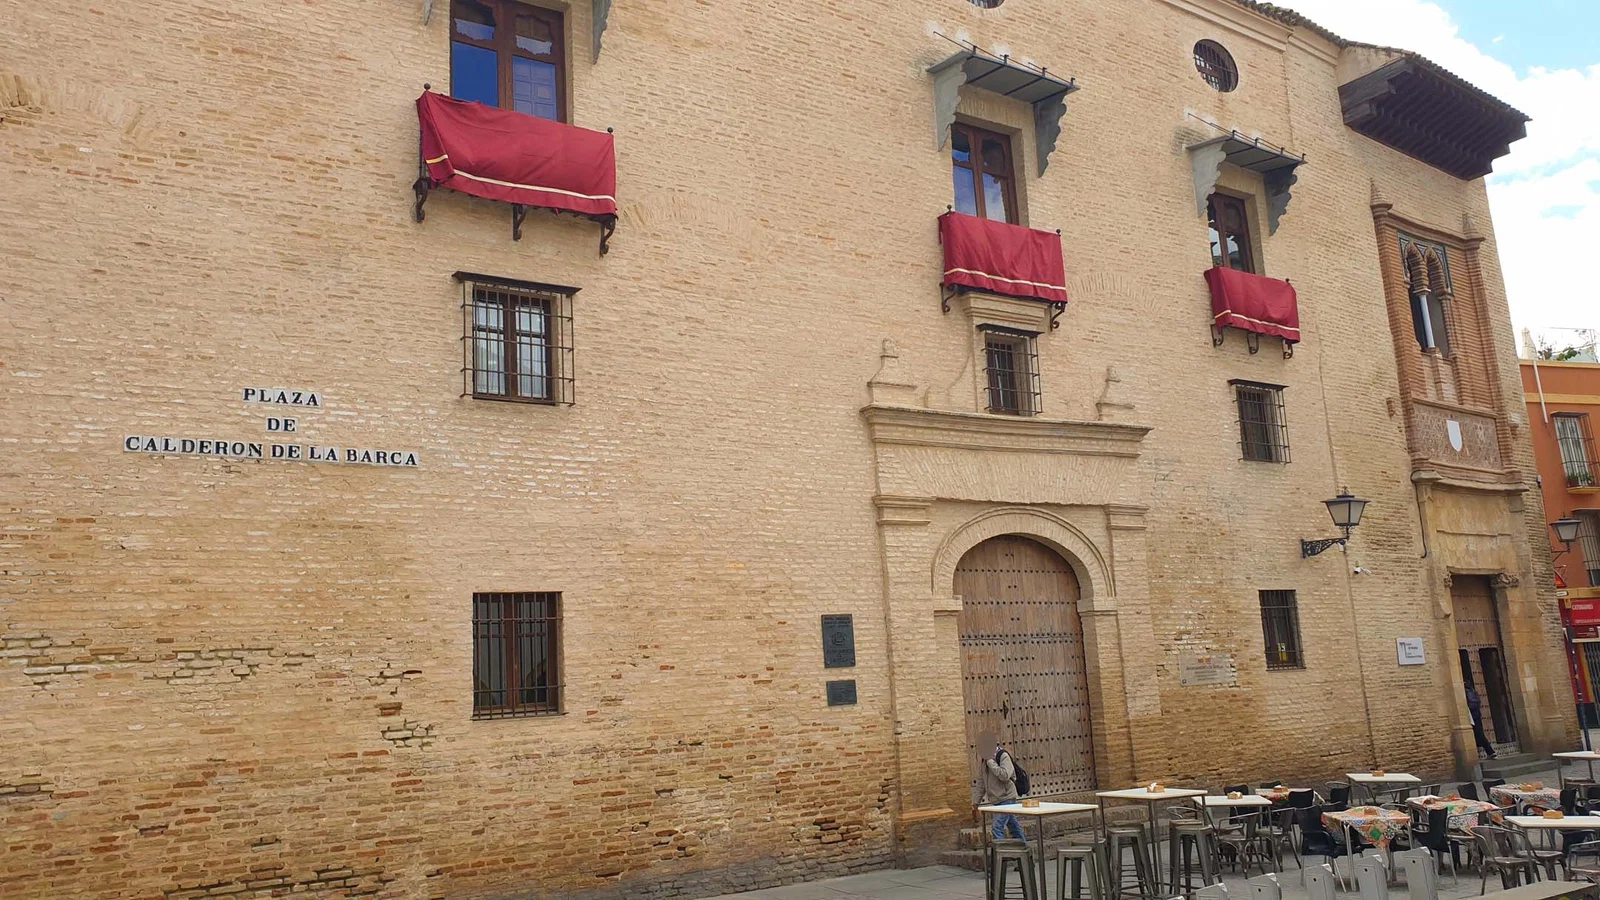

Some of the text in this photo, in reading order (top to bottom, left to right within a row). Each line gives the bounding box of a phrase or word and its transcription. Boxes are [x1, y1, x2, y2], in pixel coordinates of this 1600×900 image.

[243, 388, 319, 406] PLAZA
[267, 417, 296, 432] DE
[125, 436, 416, 466] CALDERON DE LA BARCA
